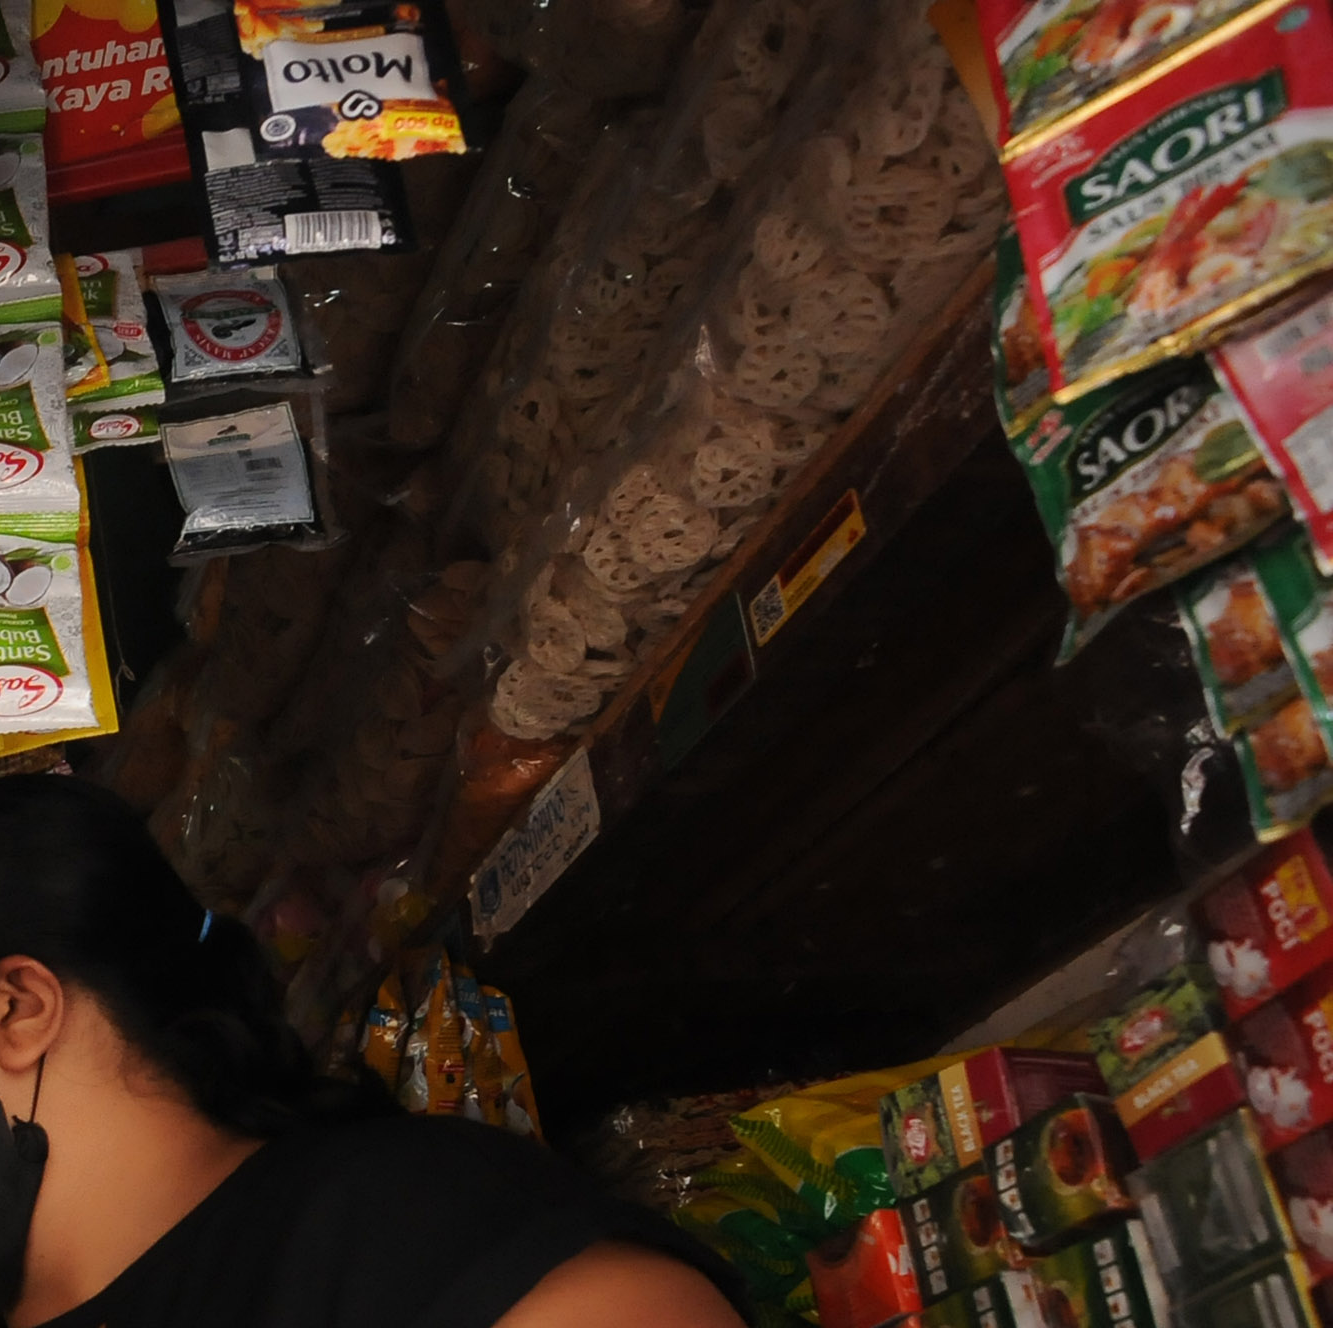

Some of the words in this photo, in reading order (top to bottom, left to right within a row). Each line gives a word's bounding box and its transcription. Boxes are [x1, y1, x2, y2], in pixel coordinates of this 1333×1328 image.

[283, 50, 414, 83] Molto
[44, 76, 140, 114] Kaya
[1079, 88, 1266, 211] SAORI
[91, 418, 137, 437] Sasa
